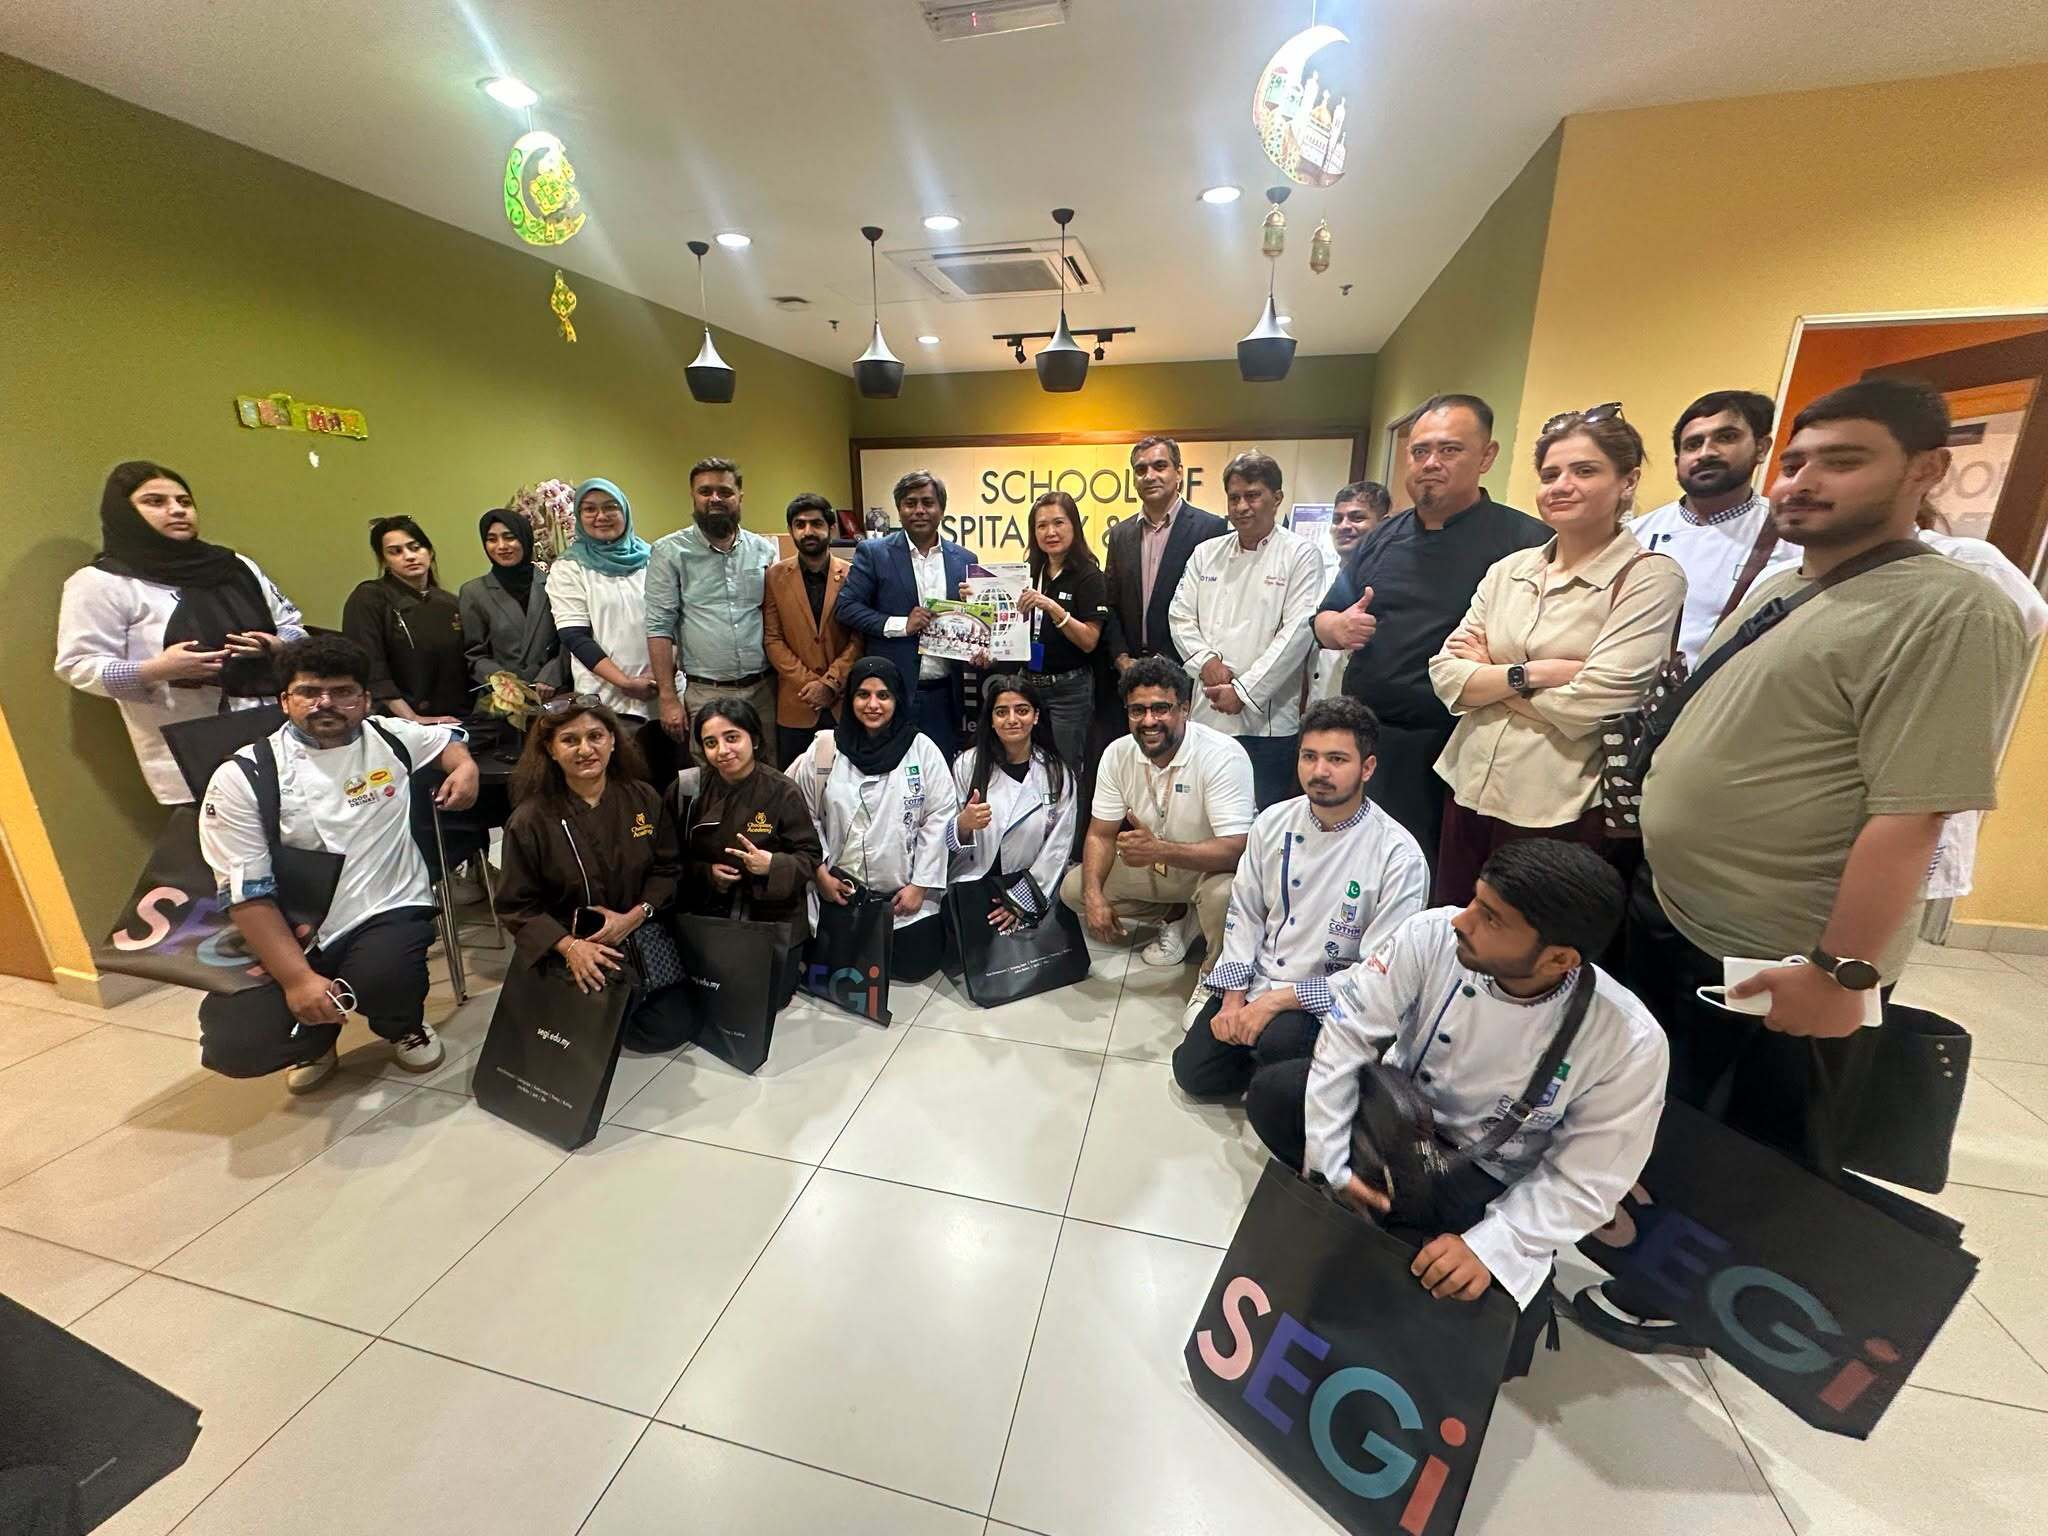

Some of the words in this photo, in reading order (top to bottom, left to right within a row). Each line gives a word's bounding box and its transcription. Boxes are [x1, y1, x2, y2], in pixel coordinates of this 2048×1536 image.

[981, 468, 1138, 504] SCHOOL
[799, 961, 880, 1019] EGi
[1197, 1276, 1467, 1536] SEGi
